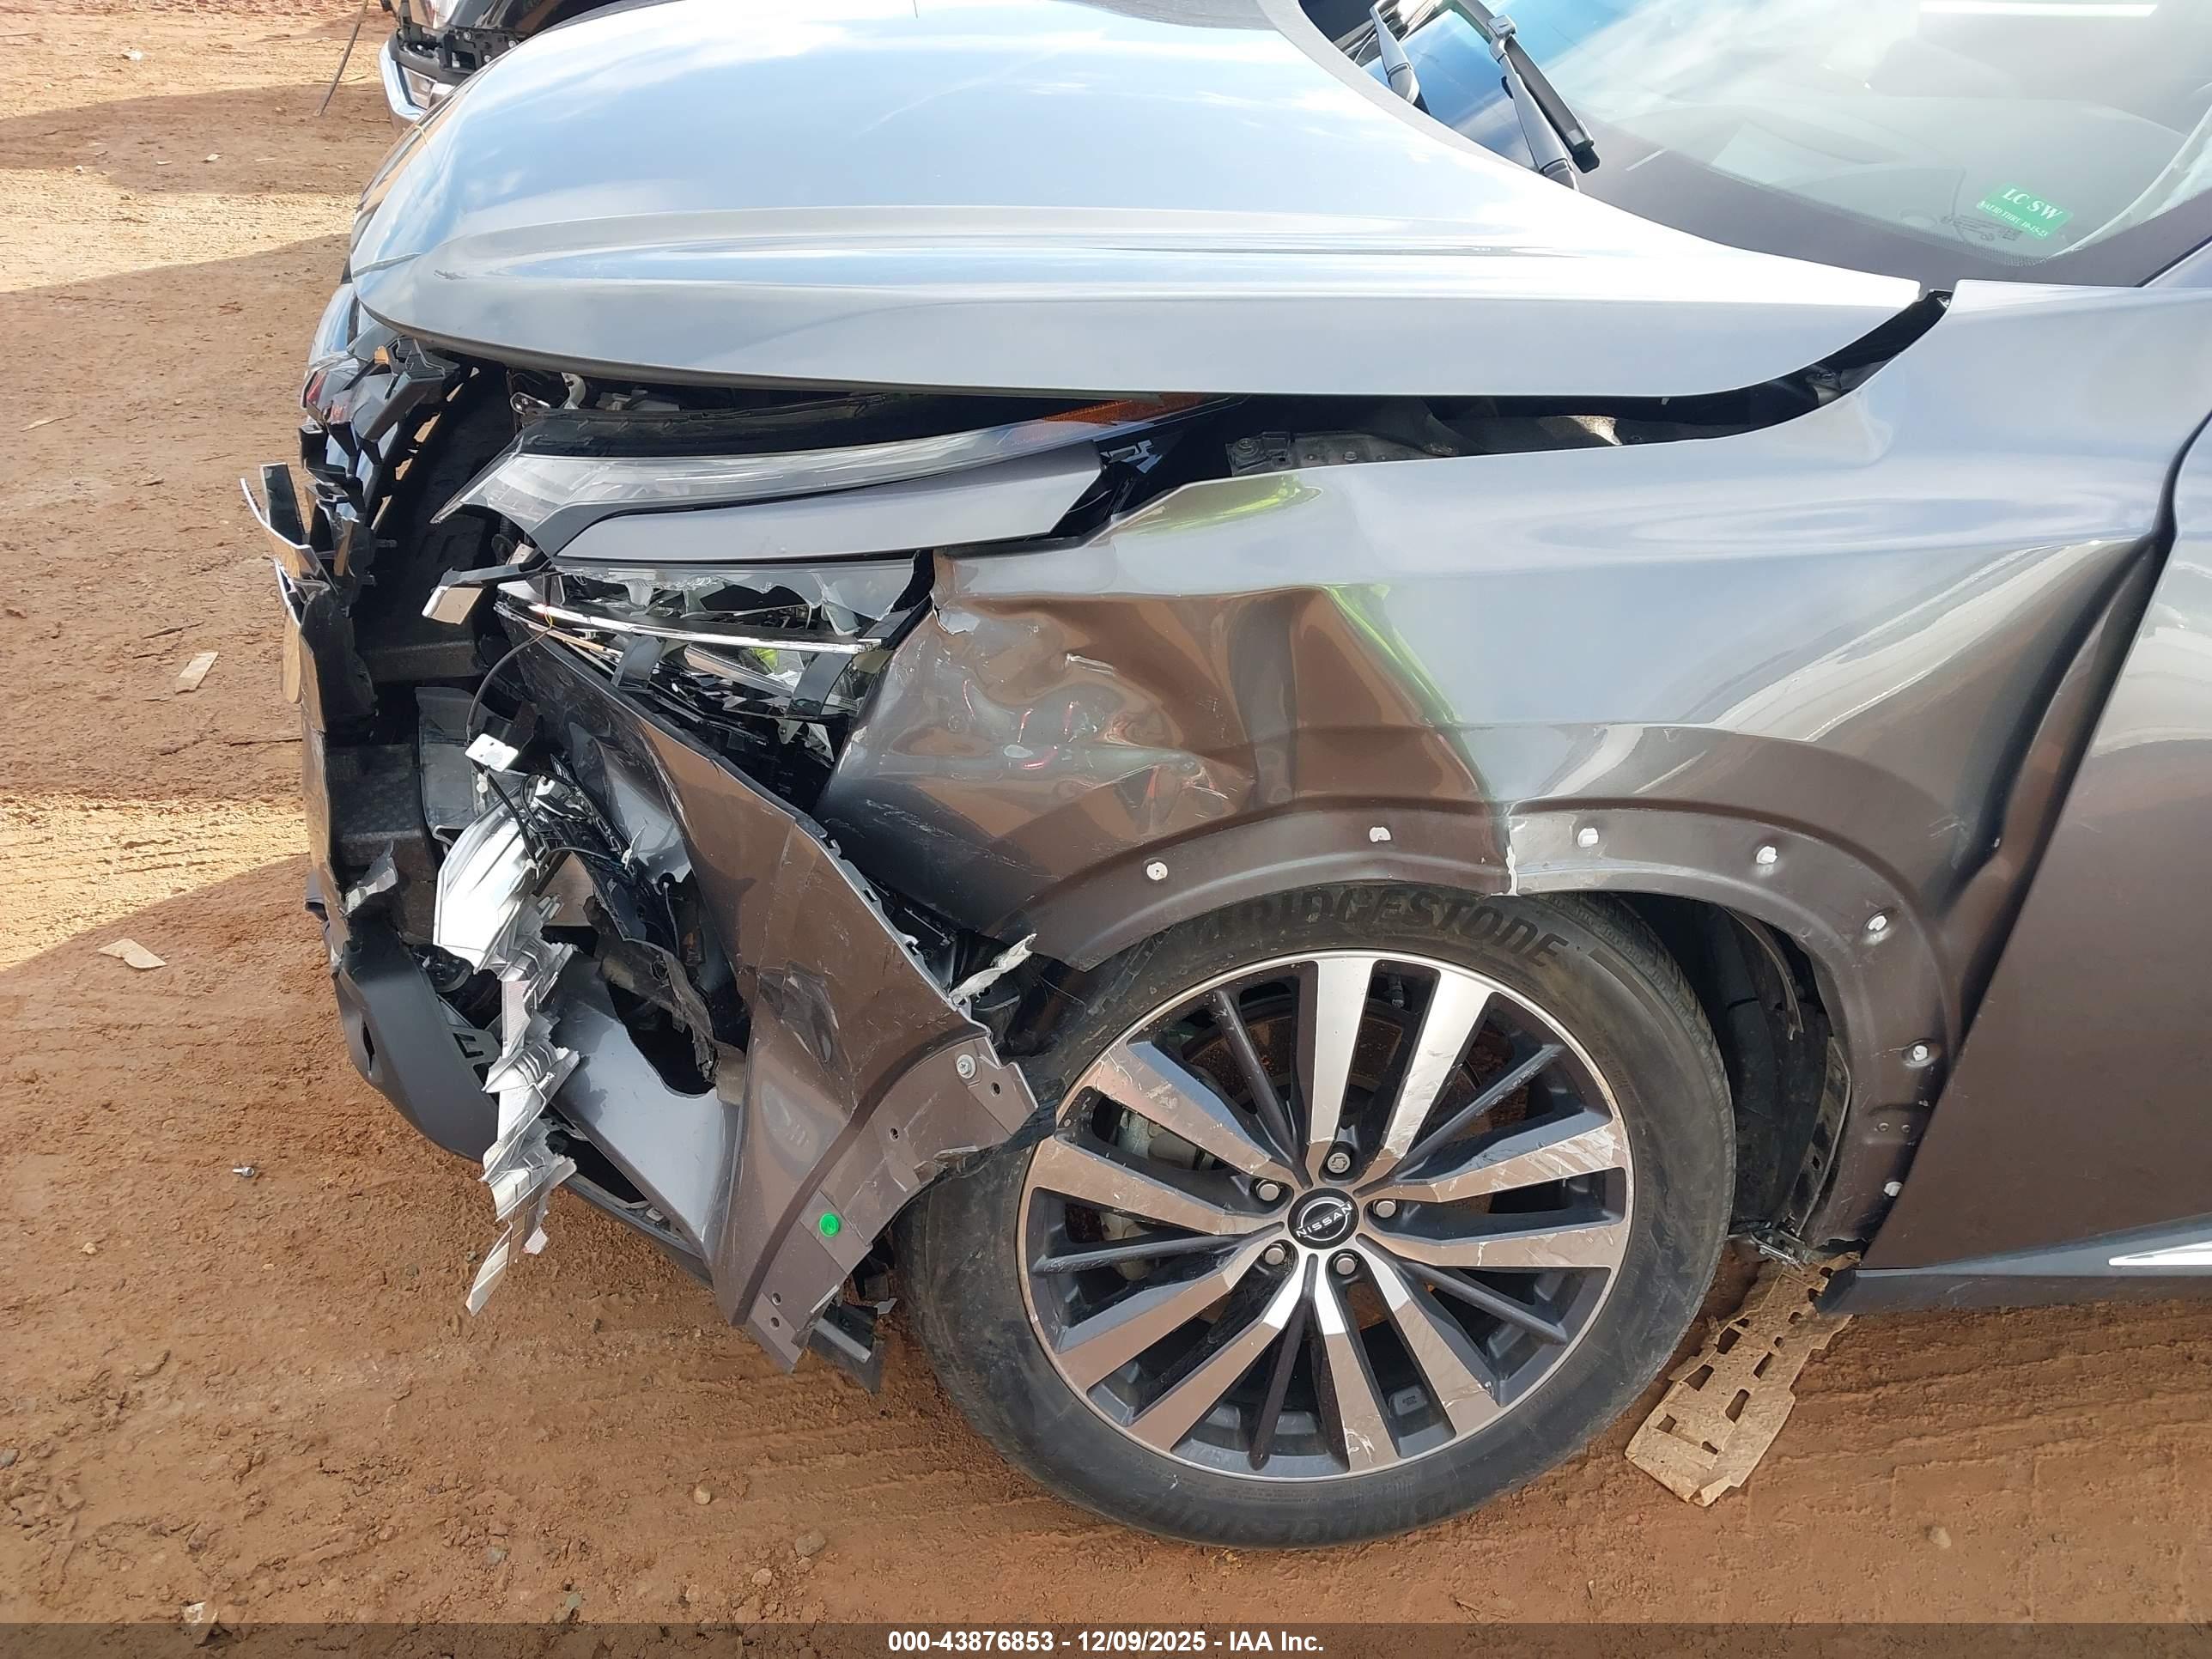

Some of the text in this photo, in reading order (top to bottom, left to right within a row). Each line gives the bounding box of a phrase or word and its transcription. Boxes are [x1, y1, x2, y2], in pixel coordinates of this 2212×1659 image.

[2002, 187, 2063, 220] LC SW
[1295, 1201, 1353, 1237] NISSAN
